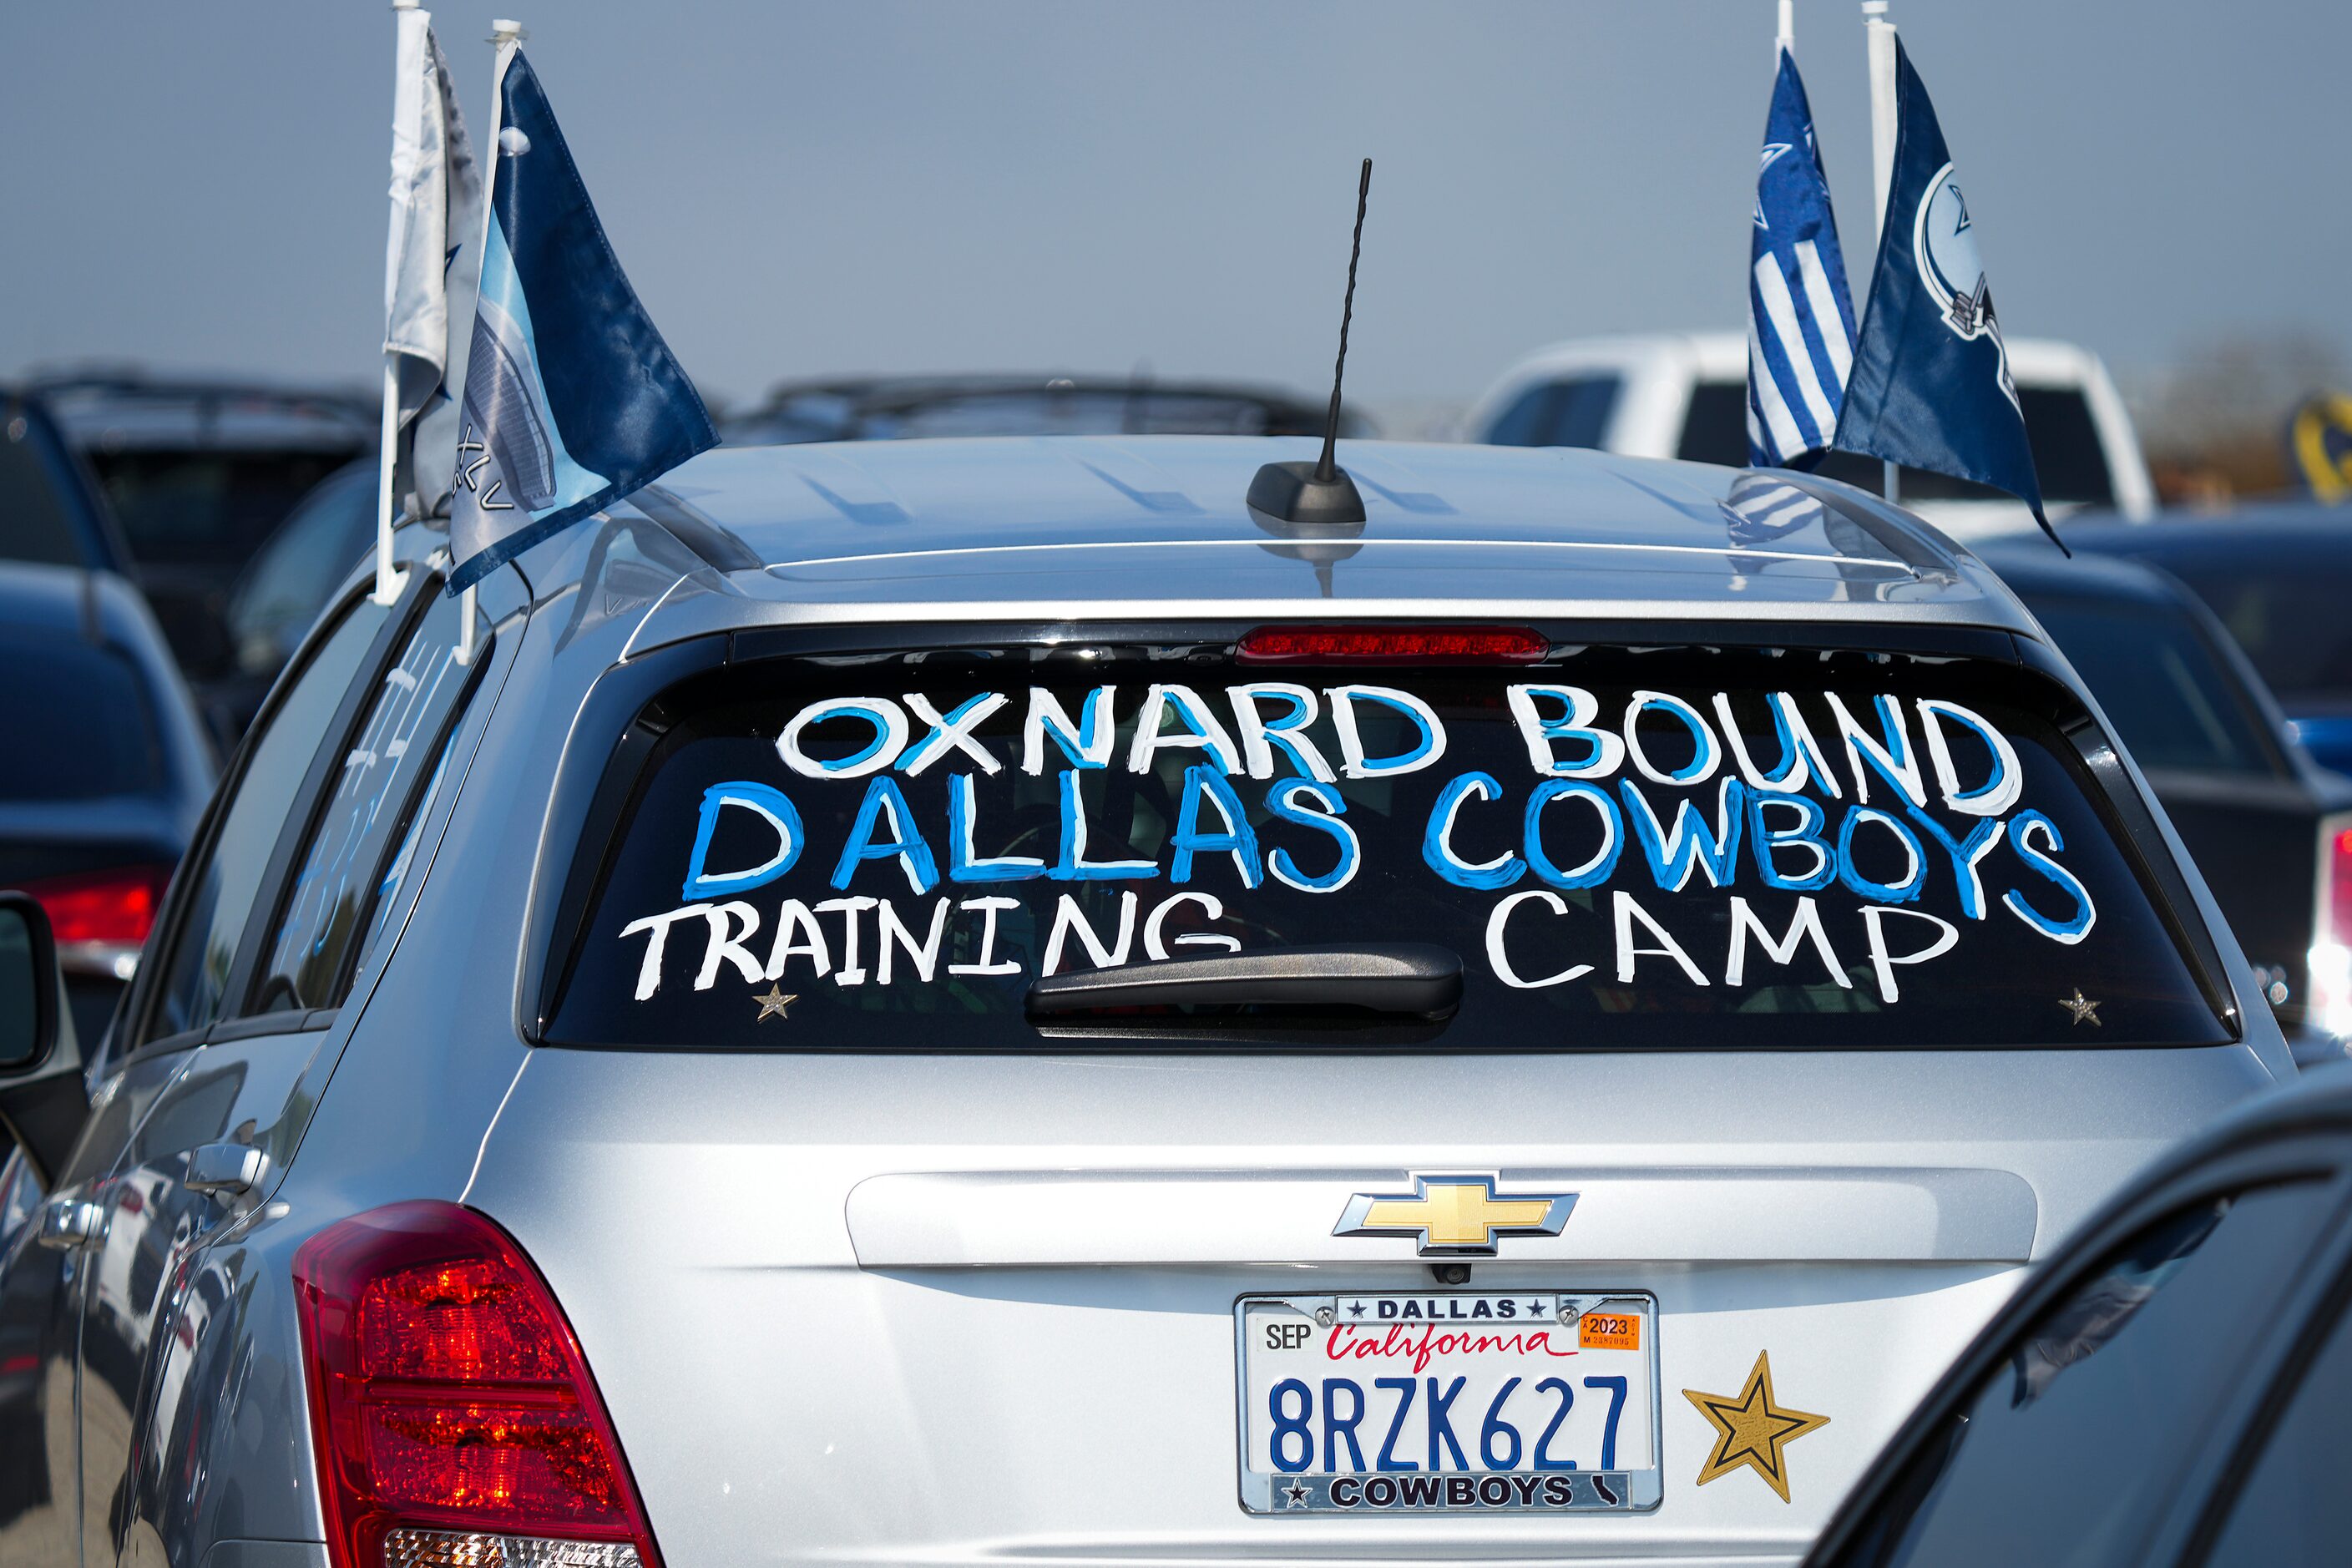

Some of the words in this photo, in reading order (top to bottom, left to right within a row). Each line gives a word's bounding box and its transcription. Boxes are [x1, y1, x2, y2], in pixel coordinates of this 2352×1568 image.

[775, 683, 1447, 779] OXNARD
[1506, 683, 2024, 815] BOUND
[681, 763, 1362, 901] DALLAS
[1422, 771, 2097, 944] COWBOYS
[619, 890, 1242, 1001] TRAINING
[1485, 890, 1960, 1003] CAMP
[1378, 1299, 1517, 1319] DALLAS
[1590, 1318, 1627, 1334] 2023
[1266, 1324, 1312, 1350] SEP
[1326, 1323, 1579, 1374] California
[1268, 1375, 1627, 1473] 8RZK627
[1329, 1475, 1575, 1508] COWBOYS
